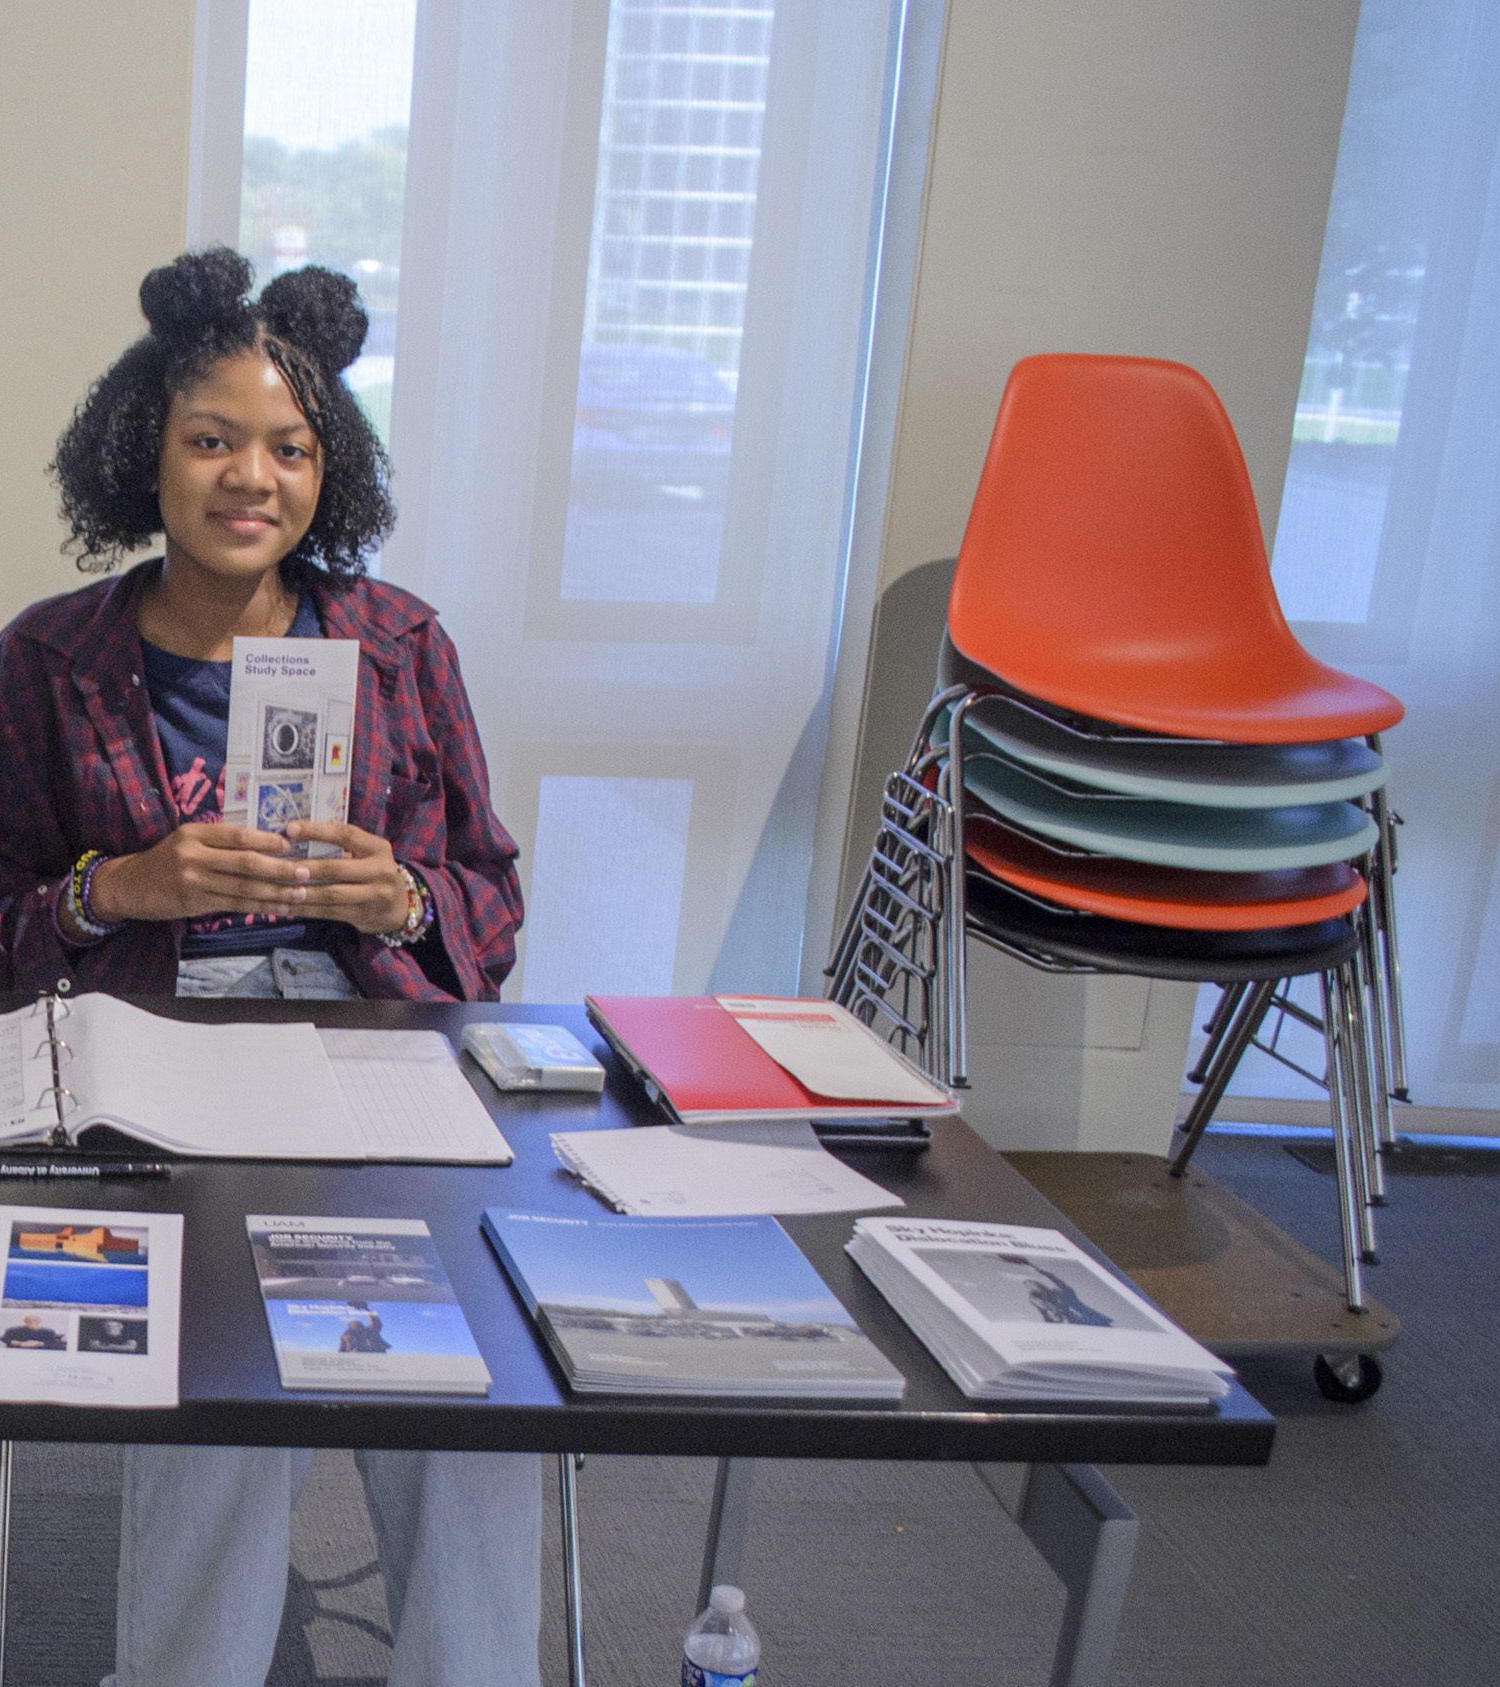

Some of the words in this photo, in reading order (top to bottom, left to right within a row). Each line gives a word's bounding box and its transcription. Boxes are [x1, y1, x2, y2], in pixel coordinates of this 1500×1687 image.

[245, 653, 310, 665] Collections
[245, 665, 277, 676] Study
[281, 666, 316, 677] Space
[0, 1164, 36, 1176] Albany
[37, 1166, 47, 1176] at
[50, 1164, 100, 1176] University
[264, 1220, 305, 1228] UAM
[508, 1213, 531, 1221] JOB
[531, 1215, 588, 1226] SECURITY
[886, 1224, 925, 1234] Sky
[928, 1225, 1017, 1240] Hopinka:
[895, 1234, 1010, 1247] Dislocation
[1010, 1240, 1068, 1252] Blues
